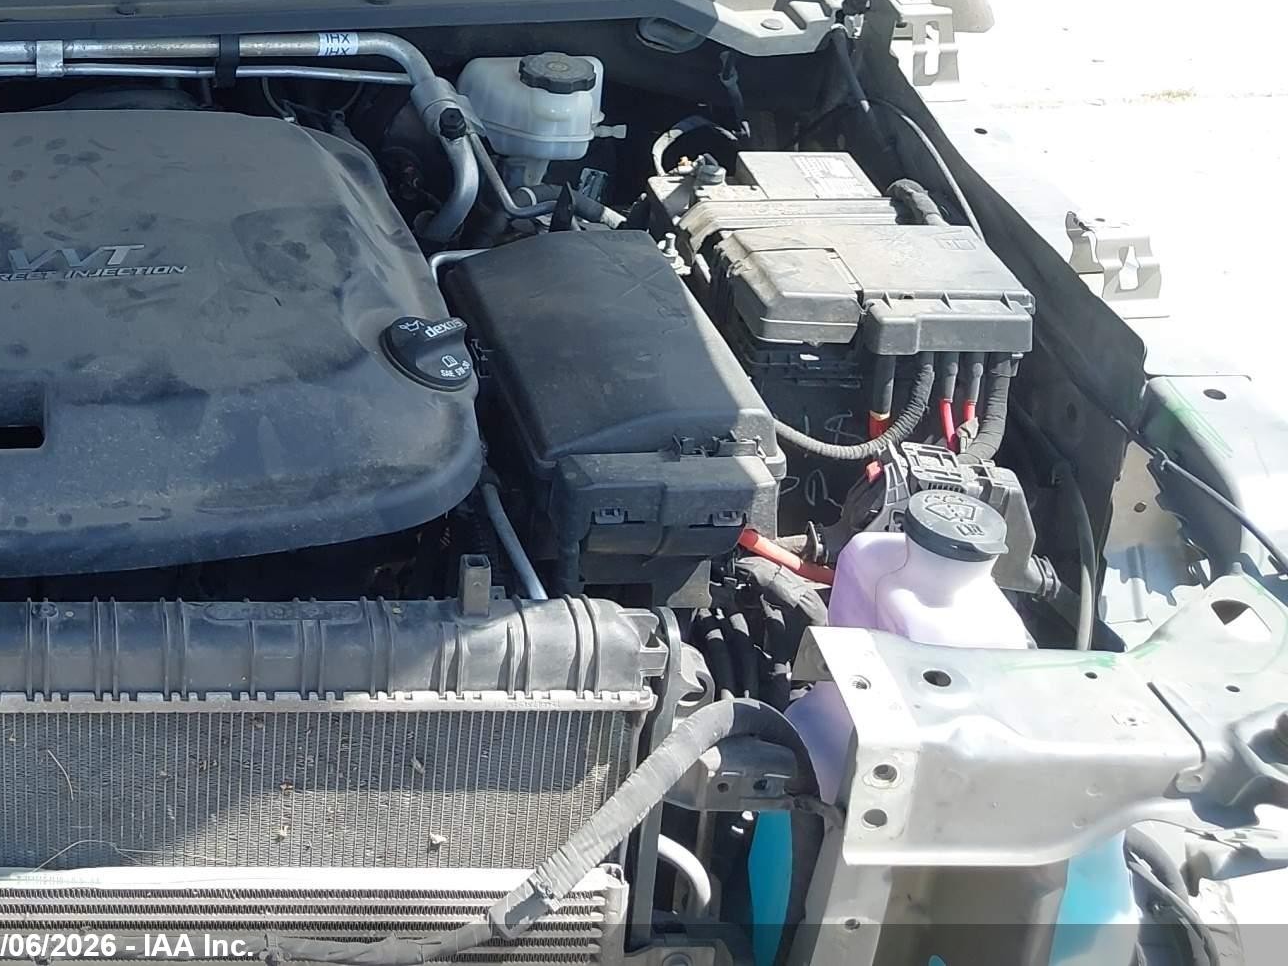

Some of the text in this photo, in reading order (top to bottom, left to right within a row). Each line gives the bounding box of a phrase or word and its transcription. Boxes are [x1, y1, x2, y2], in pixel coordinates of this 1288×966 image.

[8, 244, 145, 271] VVT
[64, 265, 188, 280] INJECTION
[425, 318, 463, 338] dexos
